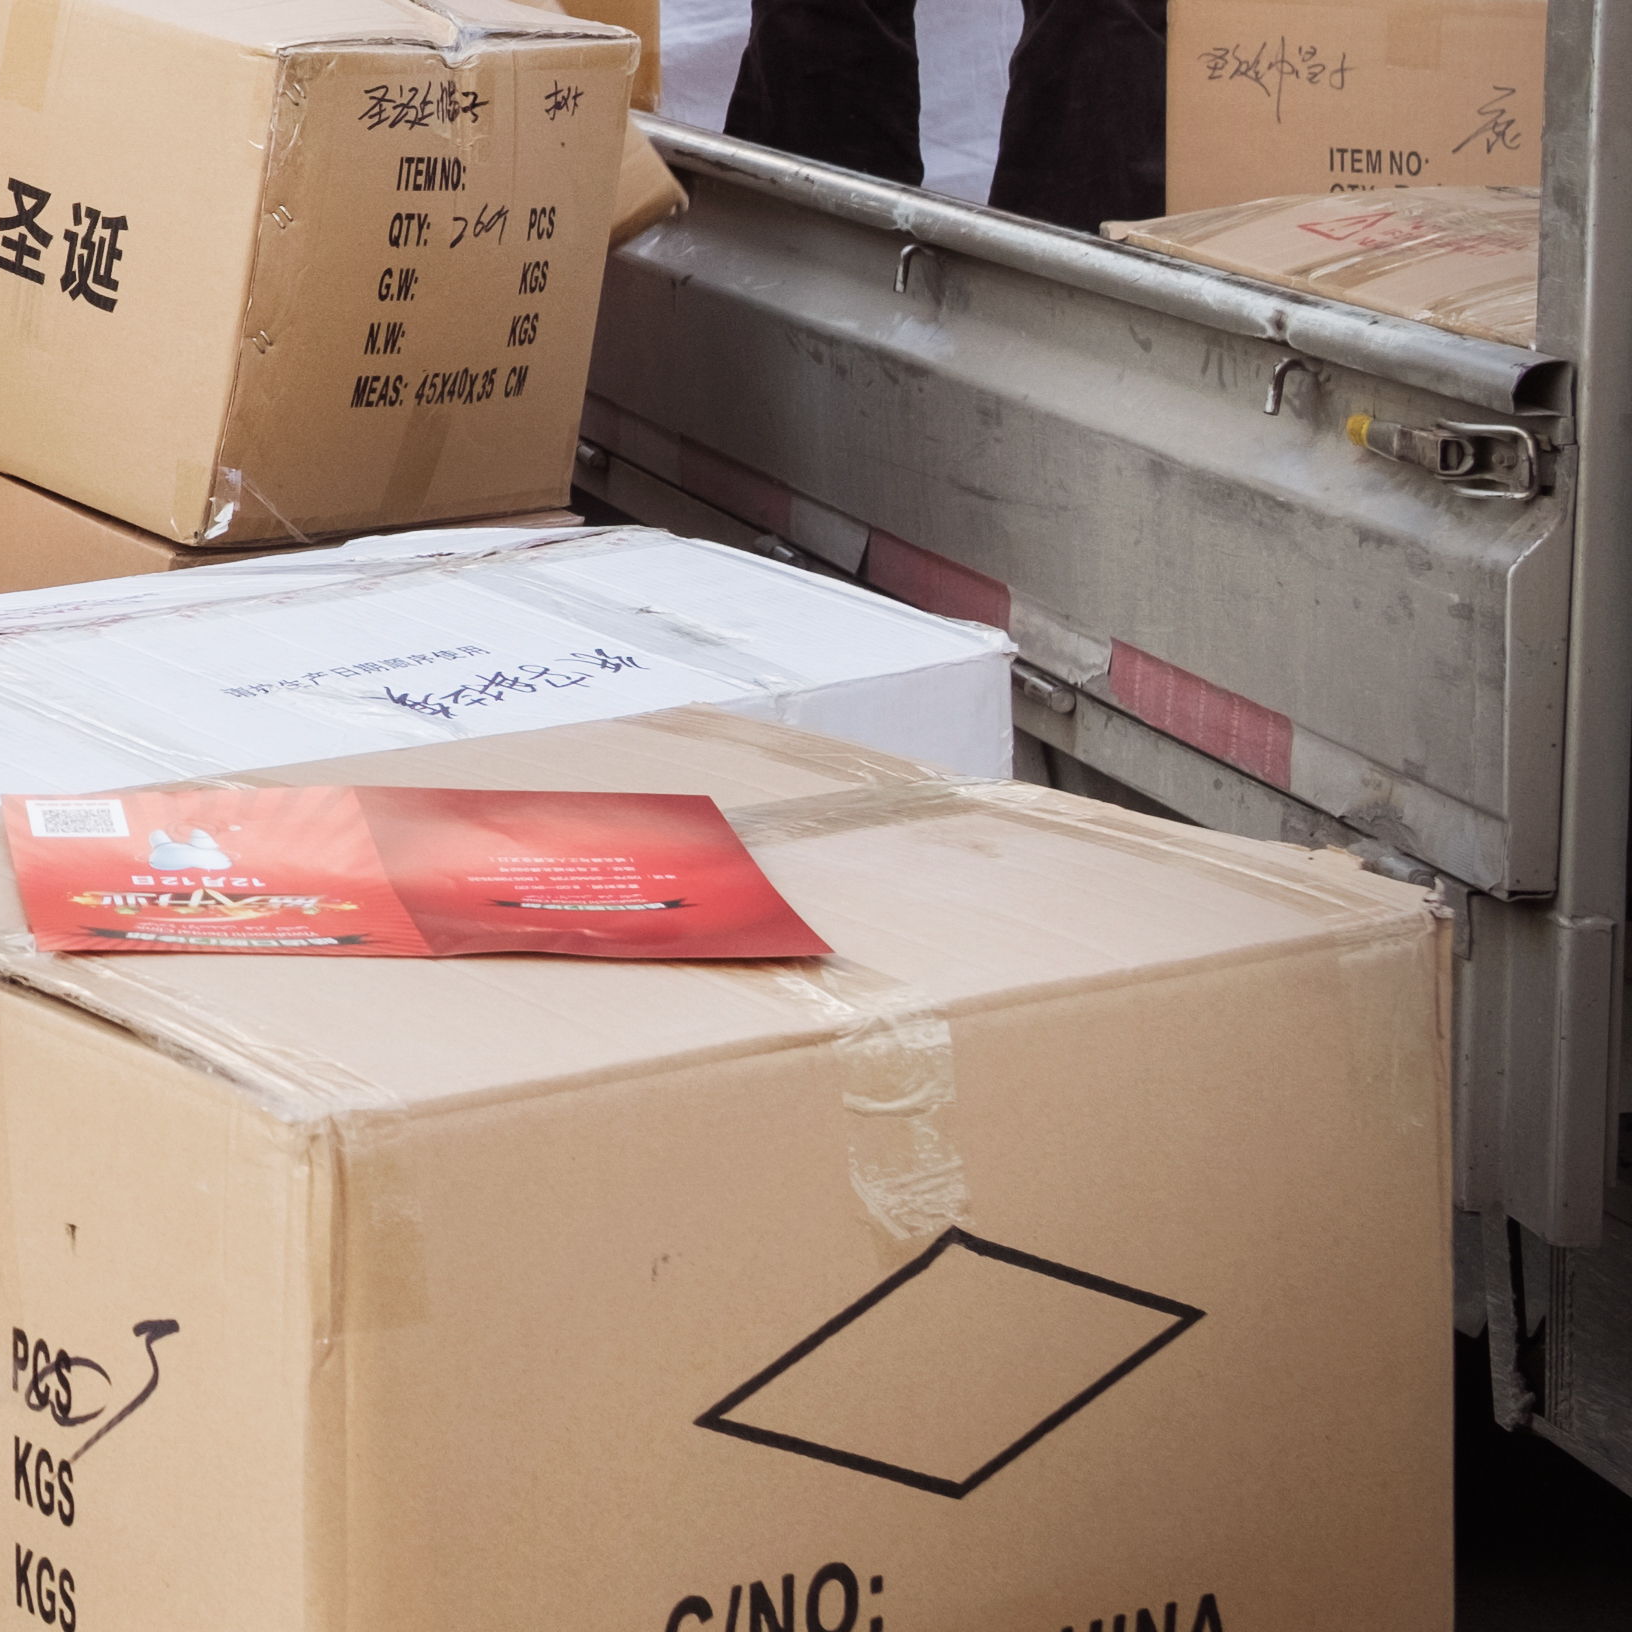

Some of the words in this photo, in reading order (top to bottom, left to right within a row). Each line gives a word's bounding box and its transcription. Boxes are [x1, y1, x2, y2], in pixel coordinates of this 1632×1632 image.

[396, 156, 438, 192] ITEM
[438, 156, 467, 192] NO:
[1328, 147, 1383, 175] ITEM
[388, 212, 432, 249] QTY:
[526, 205, 557, 242] PCS
[377, 267, 419, 302] G.W:
[518, 259, 550, 296] KGS
[363, 321, 406, 356] N.W:
[507, 312, 540, 348] KGS
[349, 374, 409, 410] MEAS:
[413, 366, 498, 407] 45X40X35
[503, 365, 530, 398] CM
[130, 874, 266, 887] 12月12日
[12, 1326, 73, 1423] PCS
[13, 1434, 76, 1528] KGS
[14, 1541, 77, 1632] KGS
